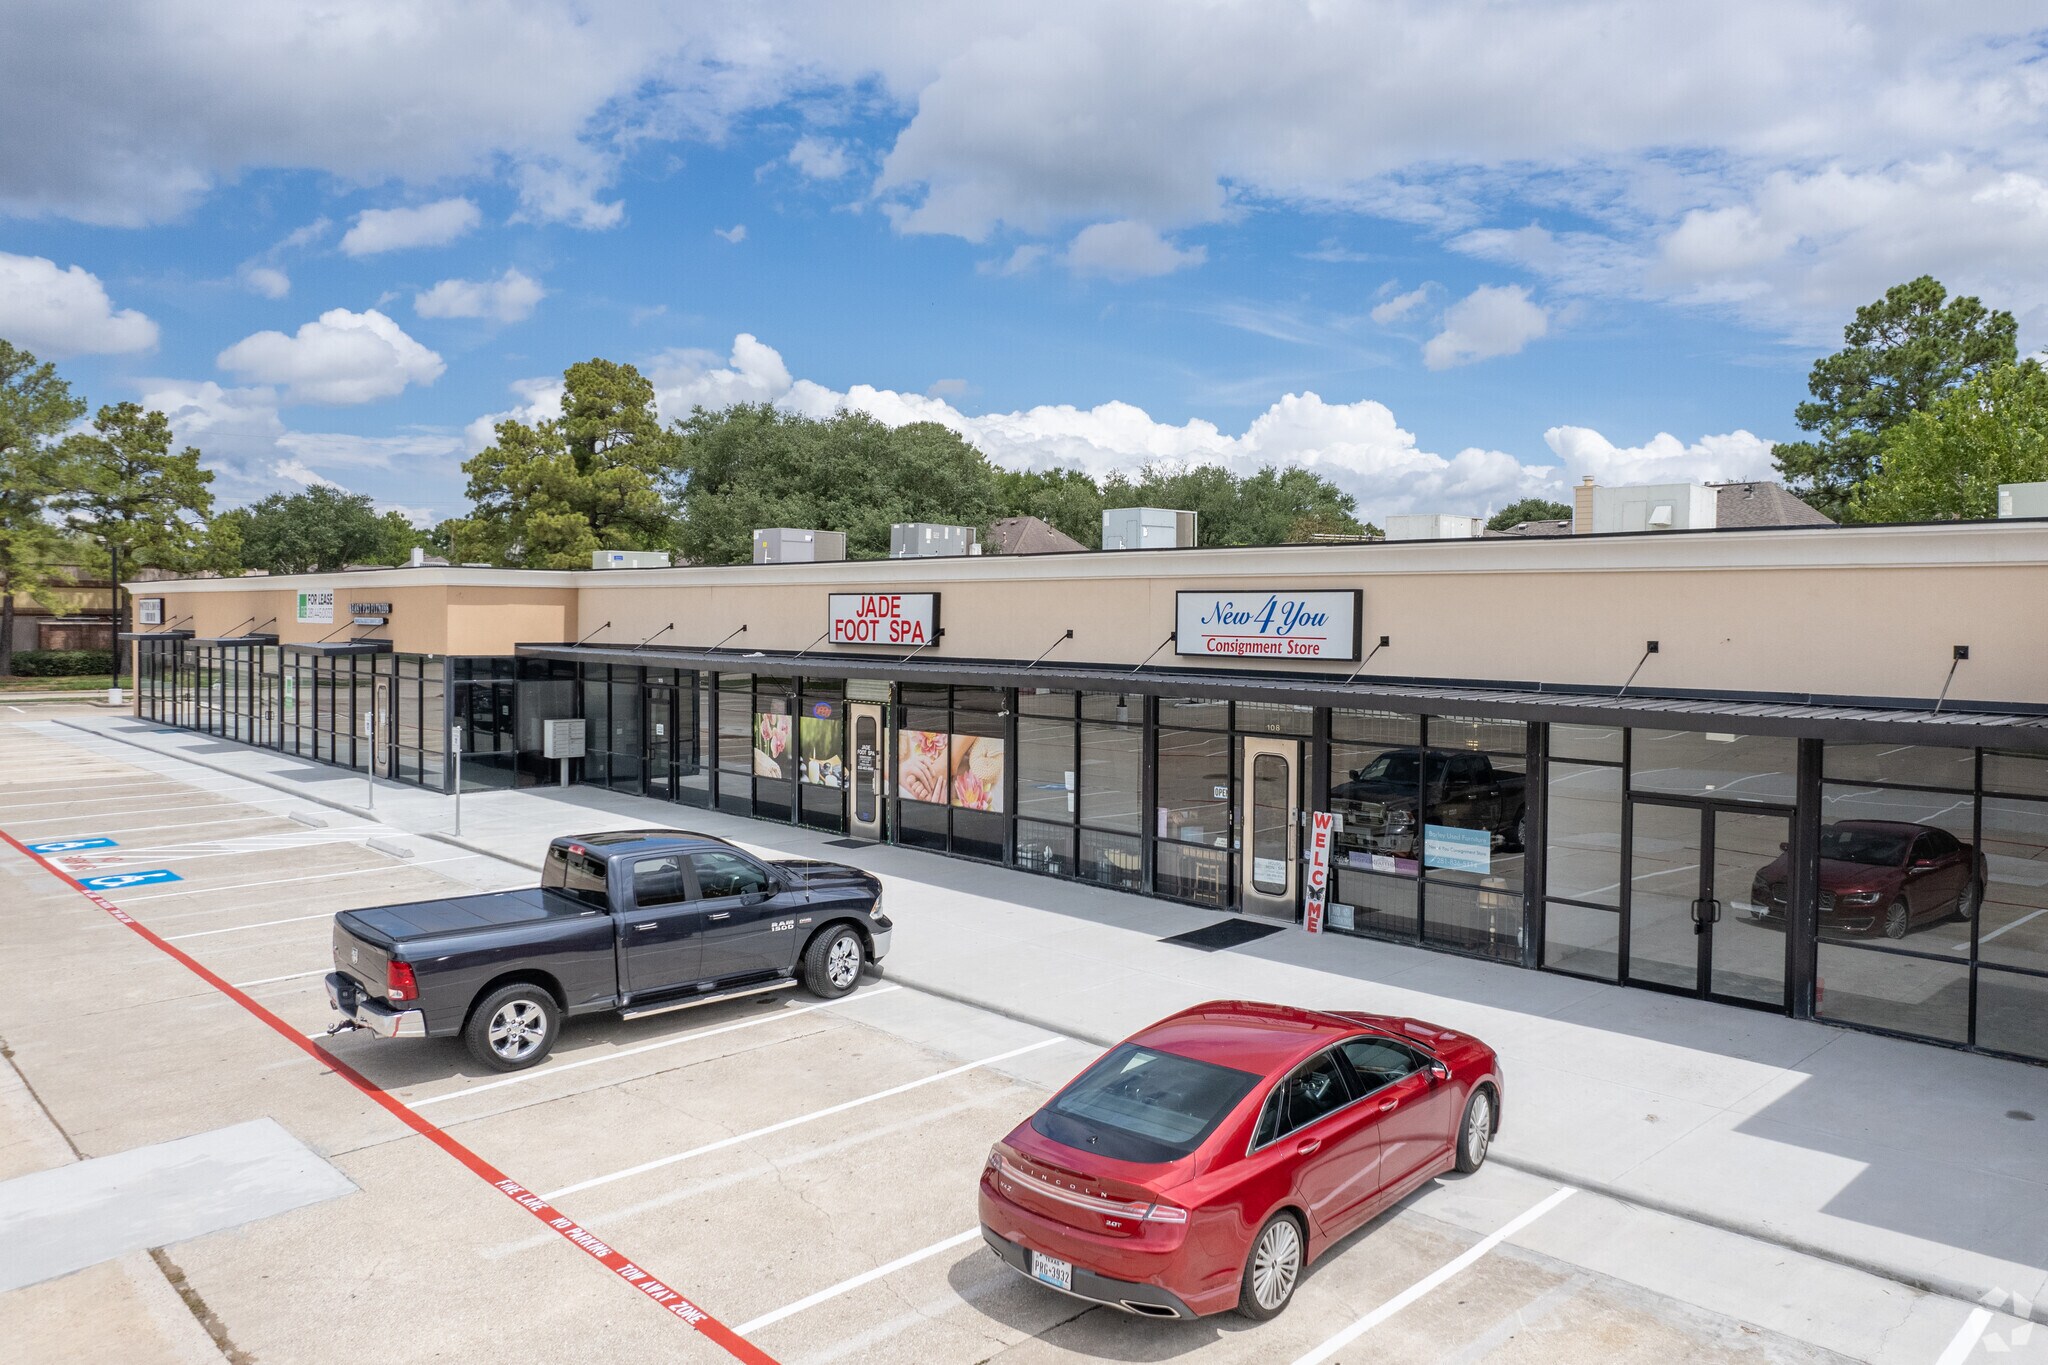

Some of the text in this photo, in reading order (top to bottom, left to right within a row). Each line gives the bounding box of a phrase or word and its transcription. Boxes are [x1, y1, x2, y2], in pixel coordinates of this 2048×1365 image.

[308, 593, 333, 605] FOR LEASE
[856, 596, 901, 618] JADE
[1201, 595, 1329, 636] New 4 You
[835, 619, 925, 643] FOOT SPA
[1207, 638, 1320, 656] Consignment Store
[1447, 832, 1461, 840] Used
[772, 924, 794, 932] 1500
[1020, 1165, 1108, 1198] LINCOLN
[495, 1179, 708, 1325] FIRE LANE NO PARKING TOW AWAY ZONE
[1045, 1256, 1060, 1266] TEXAS
